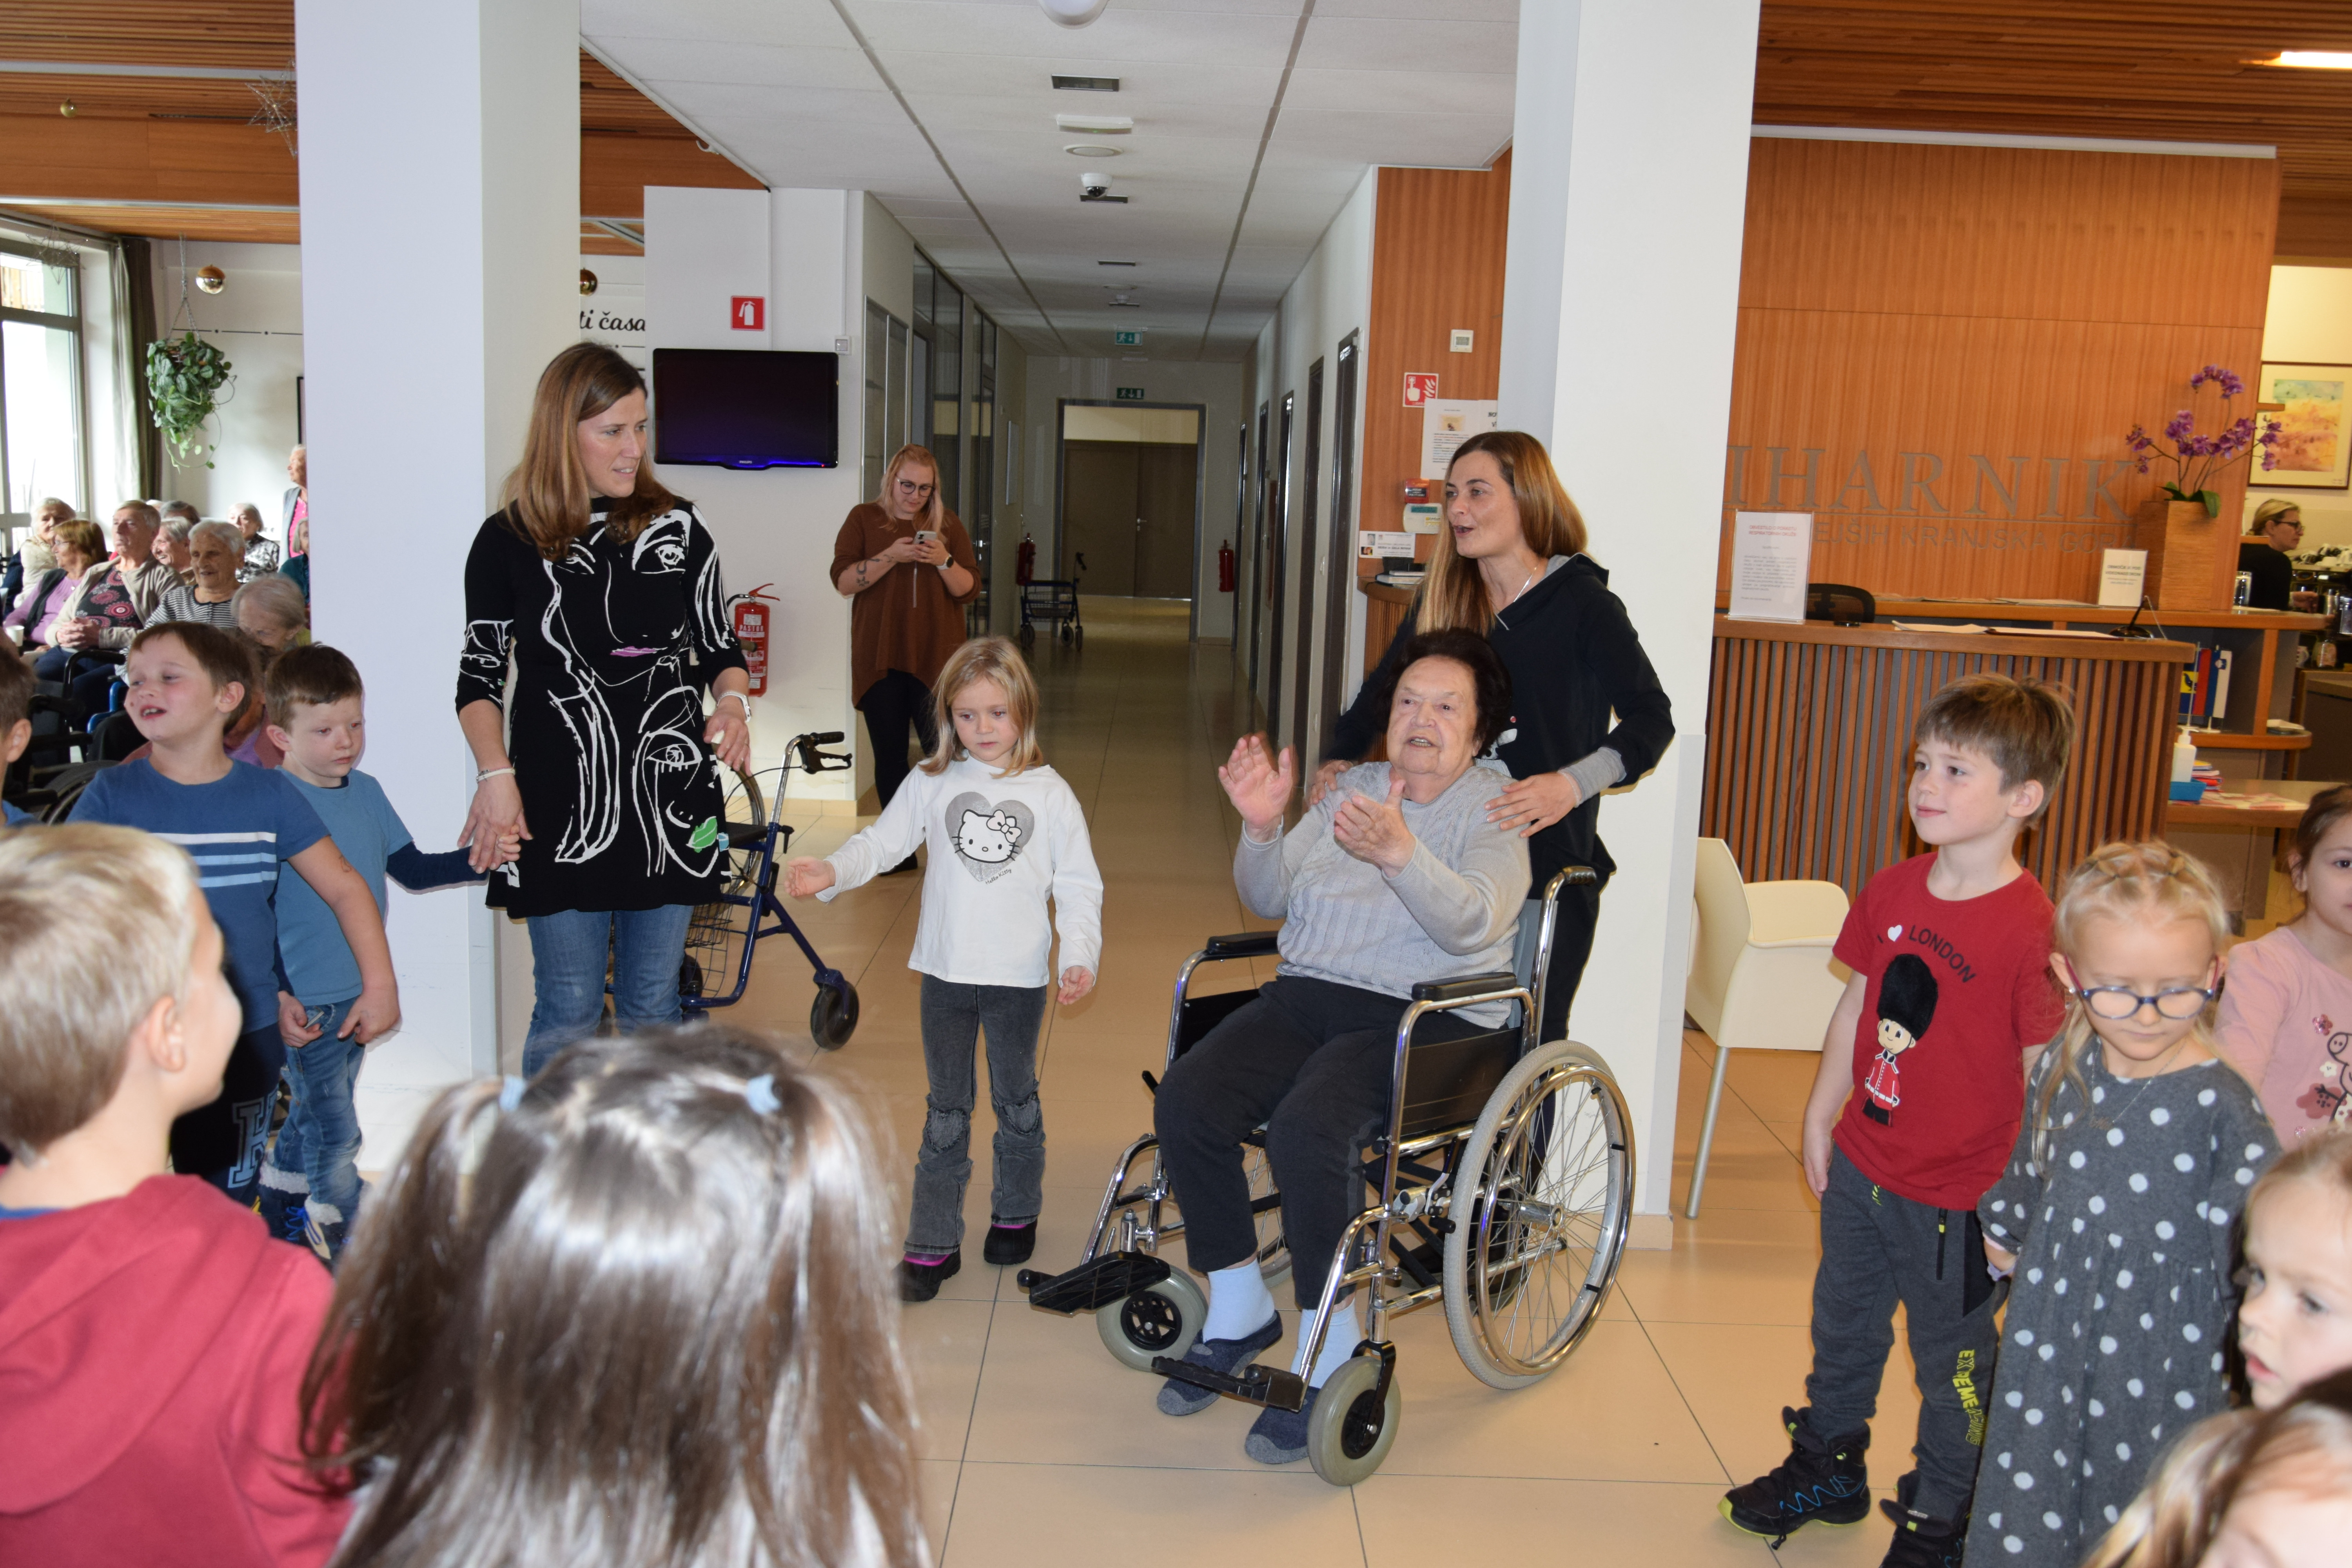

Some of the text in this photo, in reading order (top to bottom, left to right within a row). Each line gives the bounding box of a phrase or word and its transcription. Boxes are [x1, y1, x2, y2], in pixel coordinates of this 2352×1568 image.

[599, 311, 645, 331] časa
[1901, 526, 2048, 550] KRANJSKA
[985, 868, 1012, 885] Hello Kitty
[1908, 925, 1976, 983] LONDON
